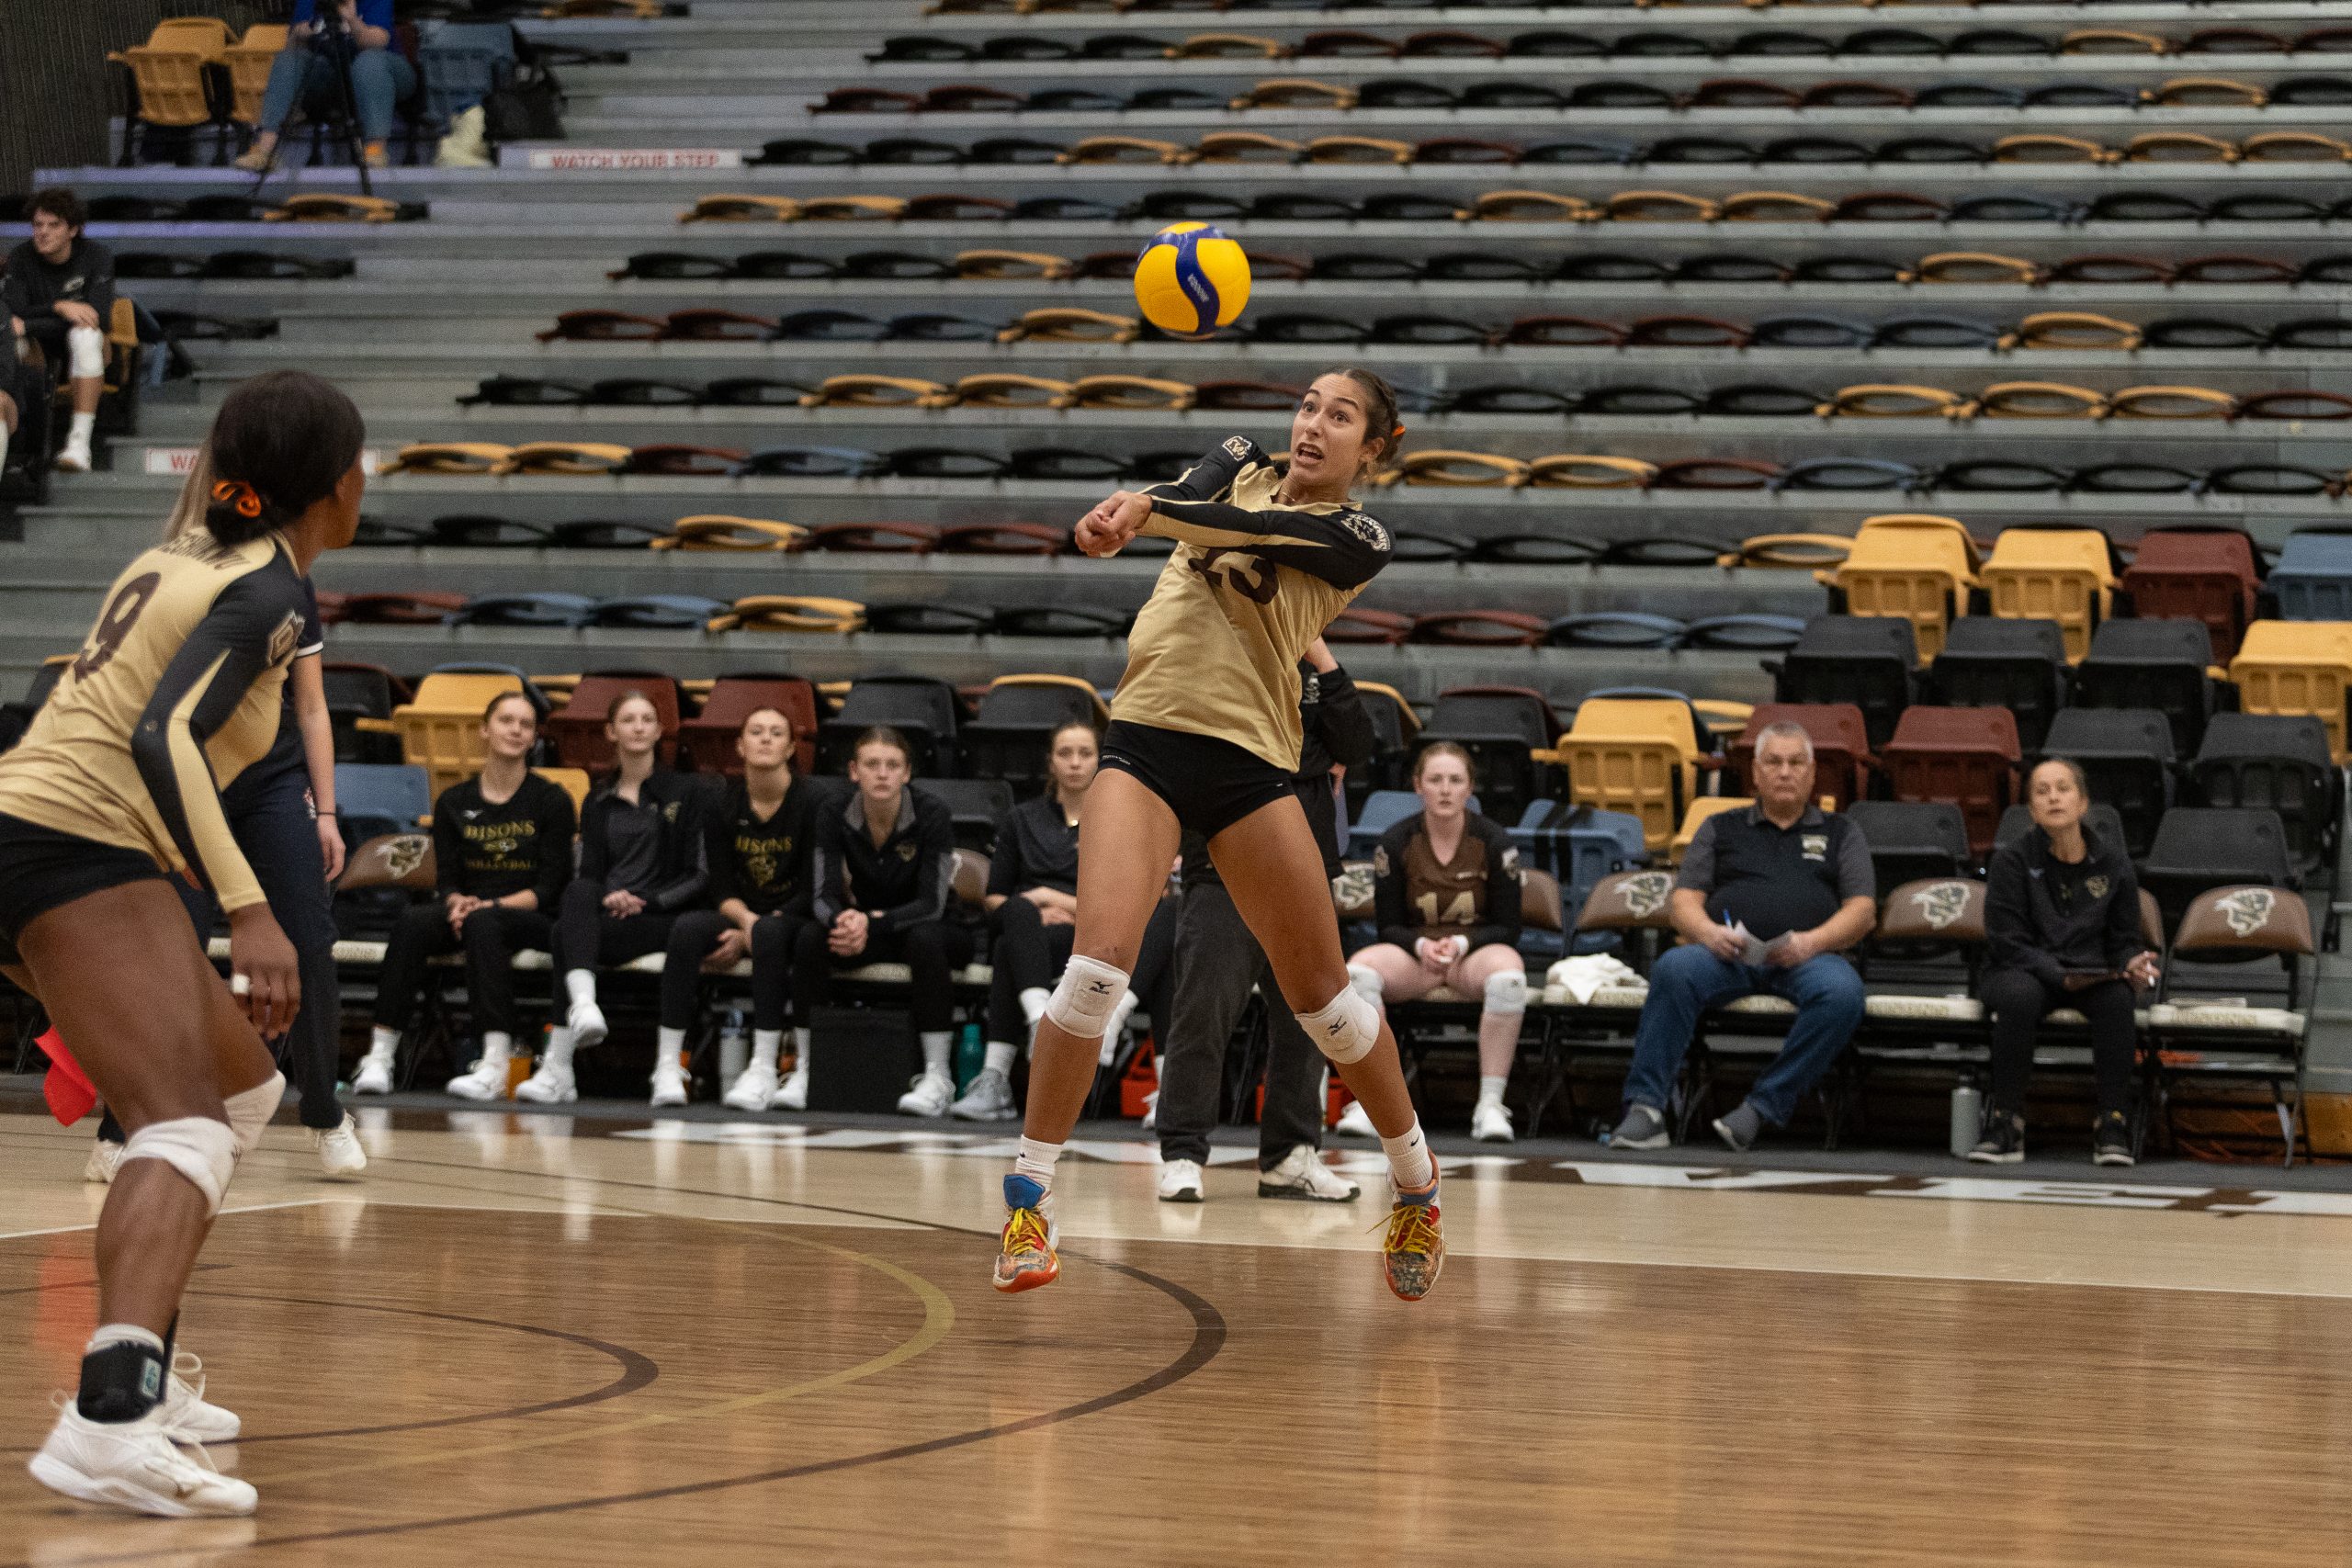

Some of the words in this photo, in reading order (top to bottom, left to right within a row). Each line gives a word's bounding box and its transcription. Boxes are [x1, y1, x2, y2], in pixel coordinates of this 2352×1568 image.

[553, 154, 613, 168] WATCH
[619, 154, 668, 168] YOUR
[674, 154, 718, 168] STEP
[74, 571, 162, 684] 9
[463, 820, 535, 840] BISONS
[1416, 890, 1476, 926] 14
